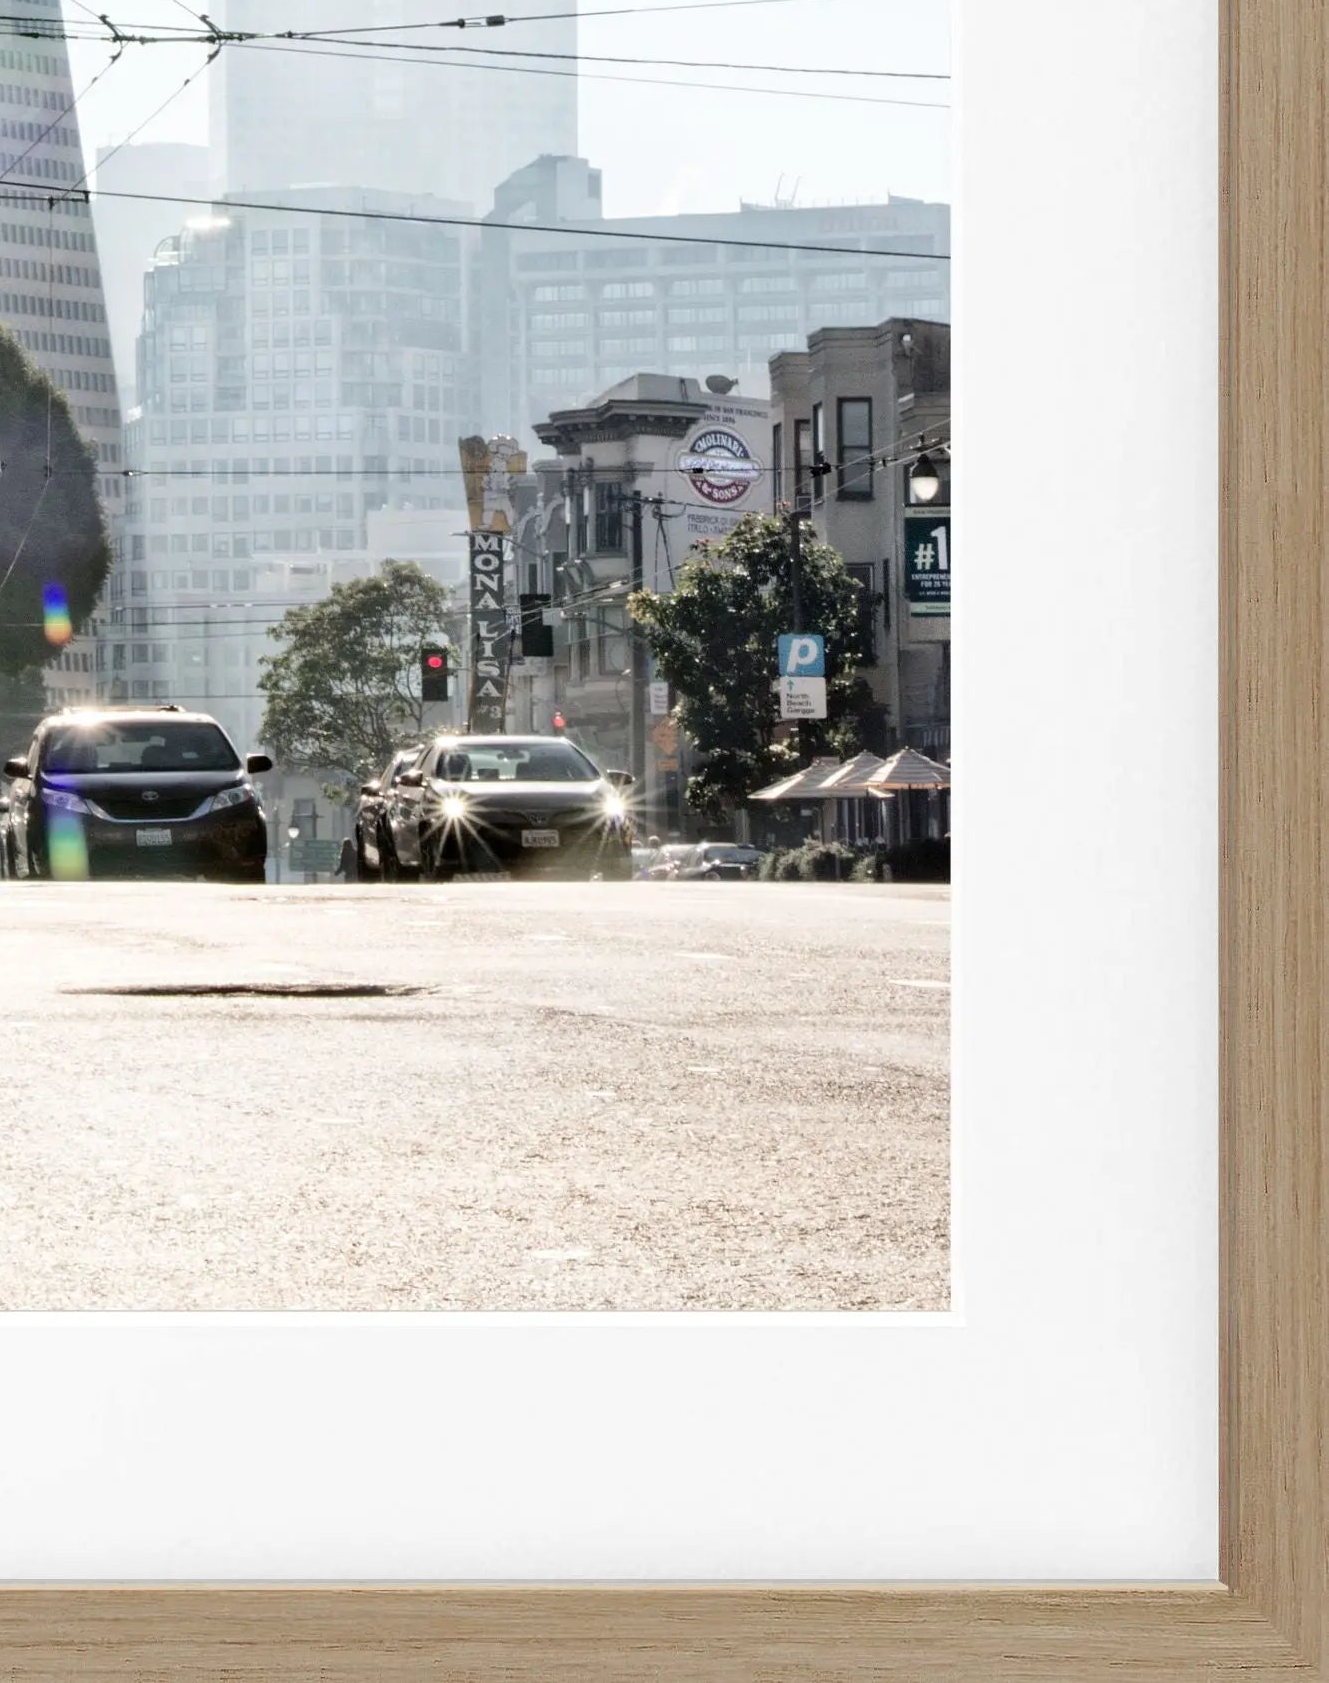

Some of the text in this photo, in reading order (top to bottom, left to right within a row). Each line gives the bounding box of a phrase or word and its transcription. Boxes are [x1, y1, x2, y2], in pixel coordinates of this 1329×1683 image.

[695, 433, 742, 457] MOLINARI
[701, 482, 738, 500] & SONS
[913, 525, 948, 570] #1
[474, 534, 501, 610] MONA
[475, 620, 503, 698] LISA
